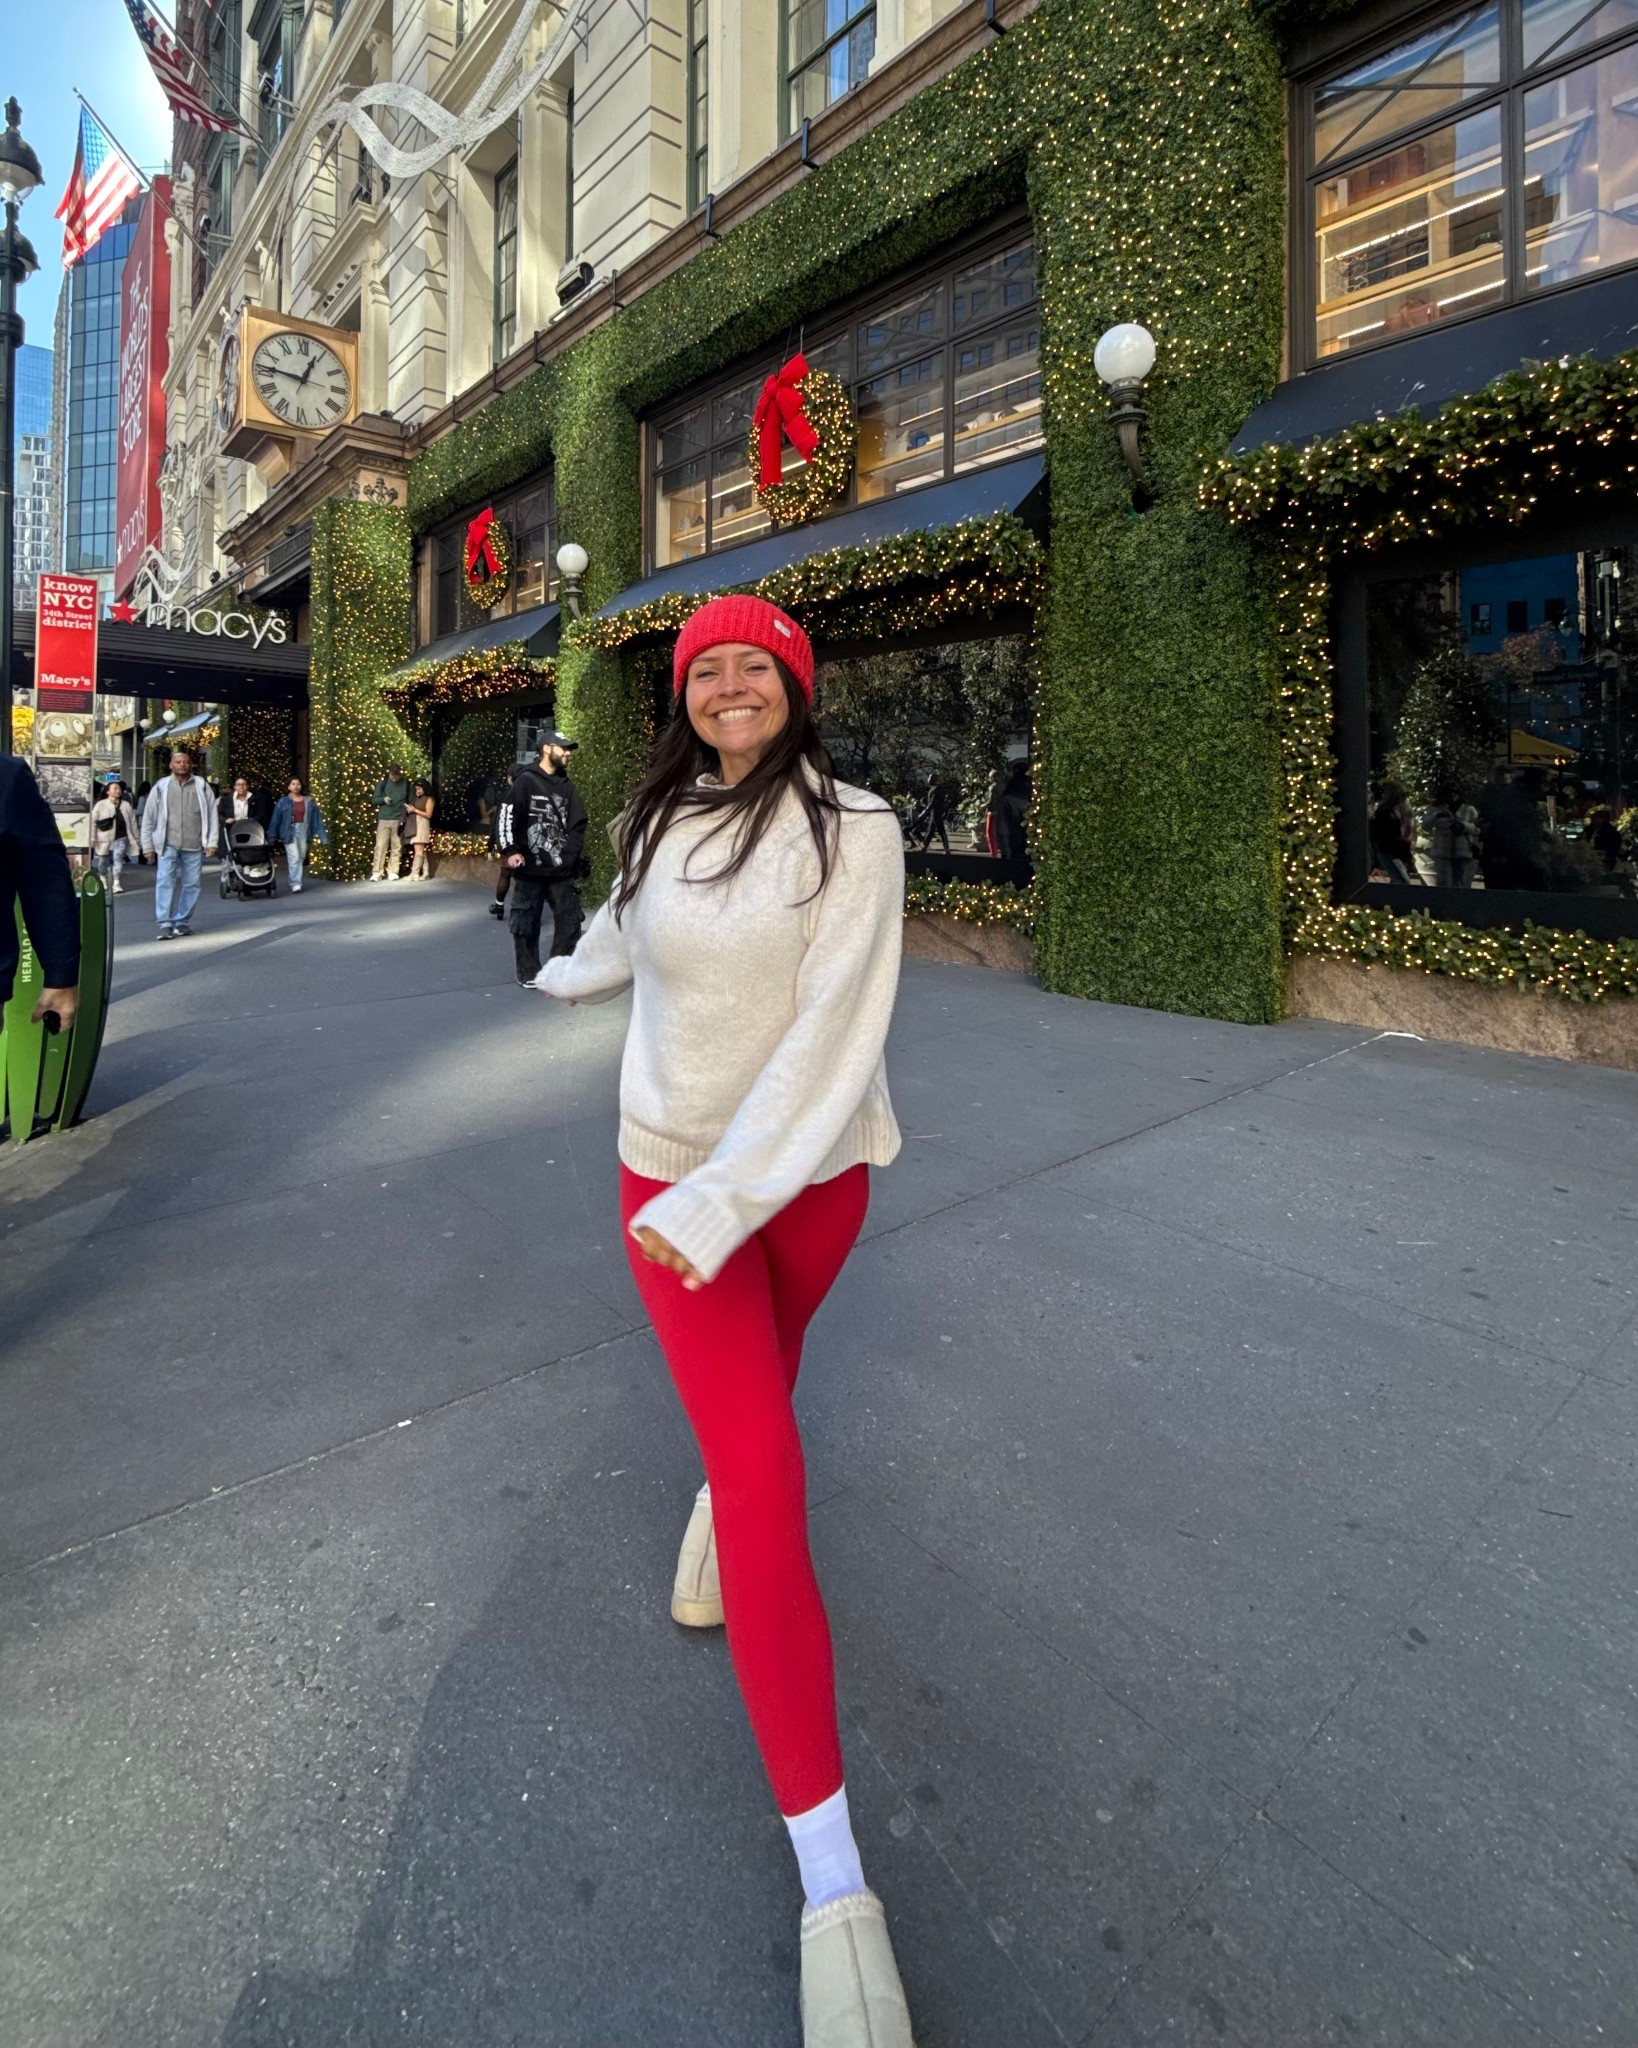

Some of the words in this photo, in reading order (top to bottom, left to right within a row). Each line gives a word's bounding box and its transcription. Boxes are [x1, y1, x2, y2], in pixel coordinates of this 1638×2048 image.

[130, 260, 142, 322] THE
[297, 338, 309, 356] XII
[262, 349, 279, 364] X
[121, 336, 147, 427] LARGEST
[123, 394, 142, 464] STORE
[43, 577, 93, 594] know
[43, 591, 93, 609] NYC
[42, 609, 64, 618] 34th
[65, 611, 93, 620] Street
[42, 617, 93, 630] district
[41, 674, 91, 687] Macy's
[22, 938, 32, 982] HERALD
